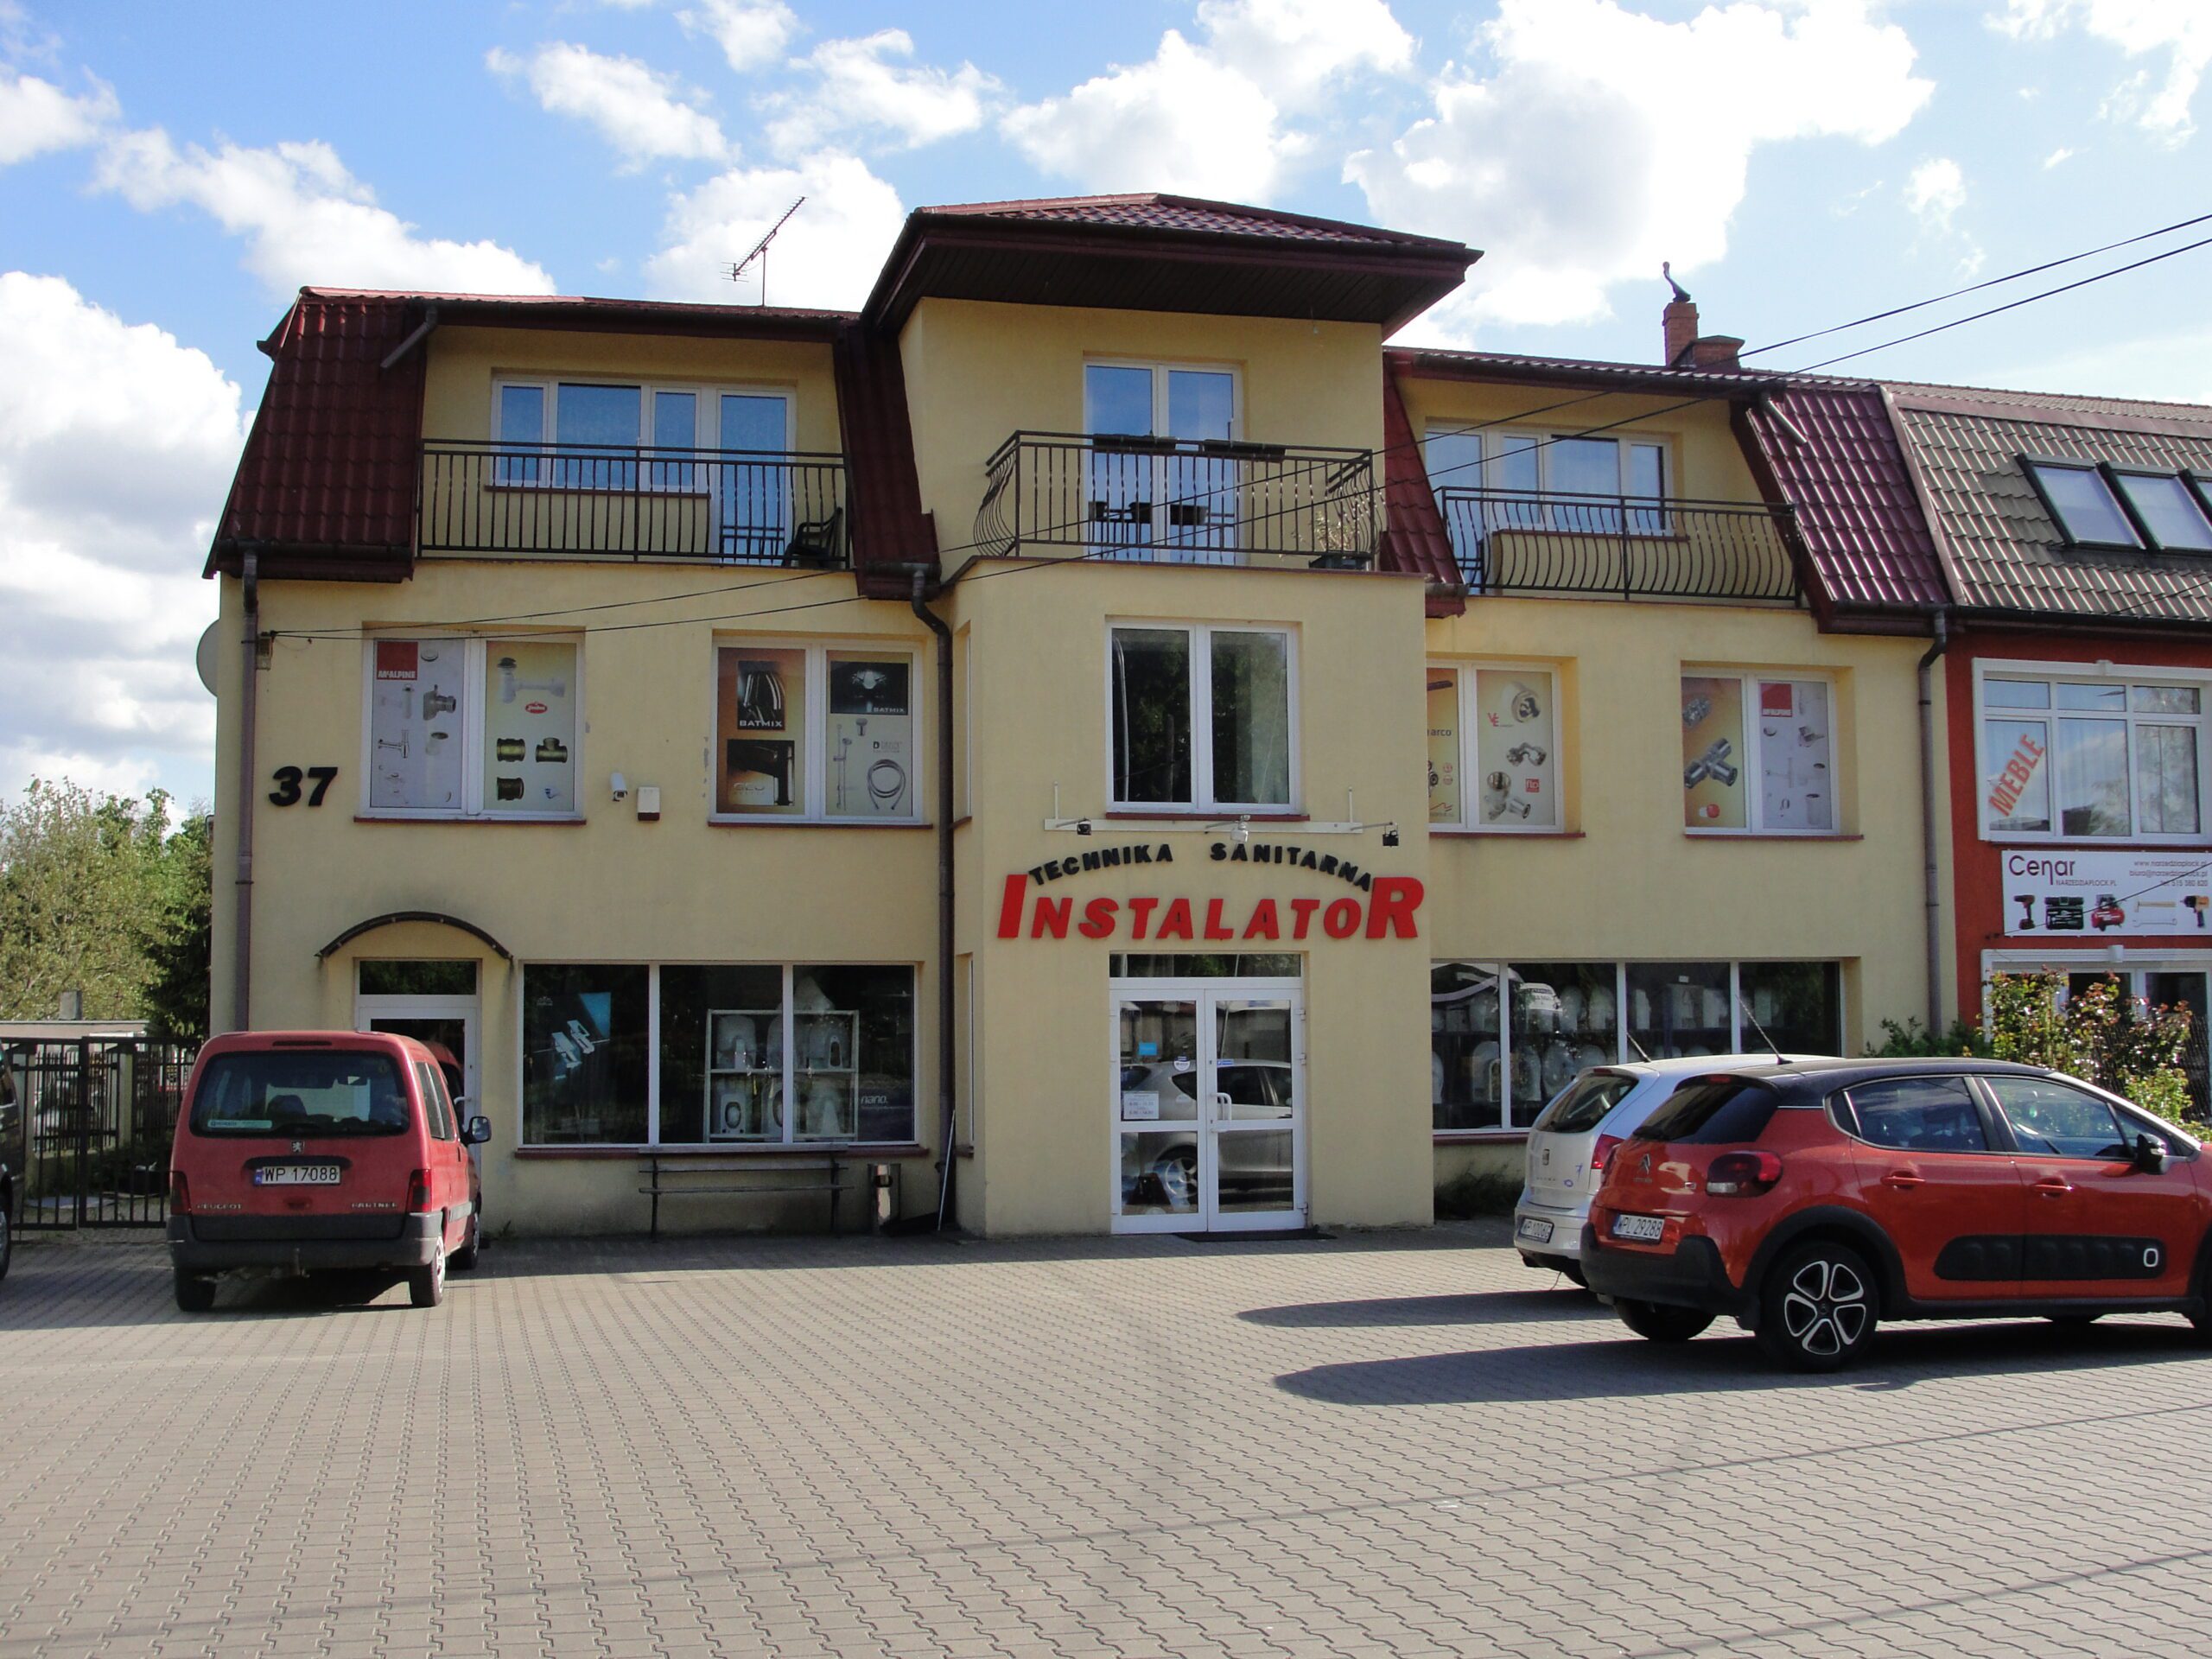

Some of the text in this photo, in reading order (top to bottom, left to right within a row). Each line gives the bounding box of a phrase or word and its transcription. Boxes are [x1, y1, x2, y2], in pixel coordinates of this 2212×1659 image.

[269, 766, 338, 806] 37
[1989, 734, 2046, 817] MEBLE
[1028, 842, 1372, 892] TECHNIKA SANITARNA
[2008, 855, 2075, 886] Cenar
[998, 874, 1425, 939] INSTALATOR
[265, 1167, 337, 1182] WP 17088
